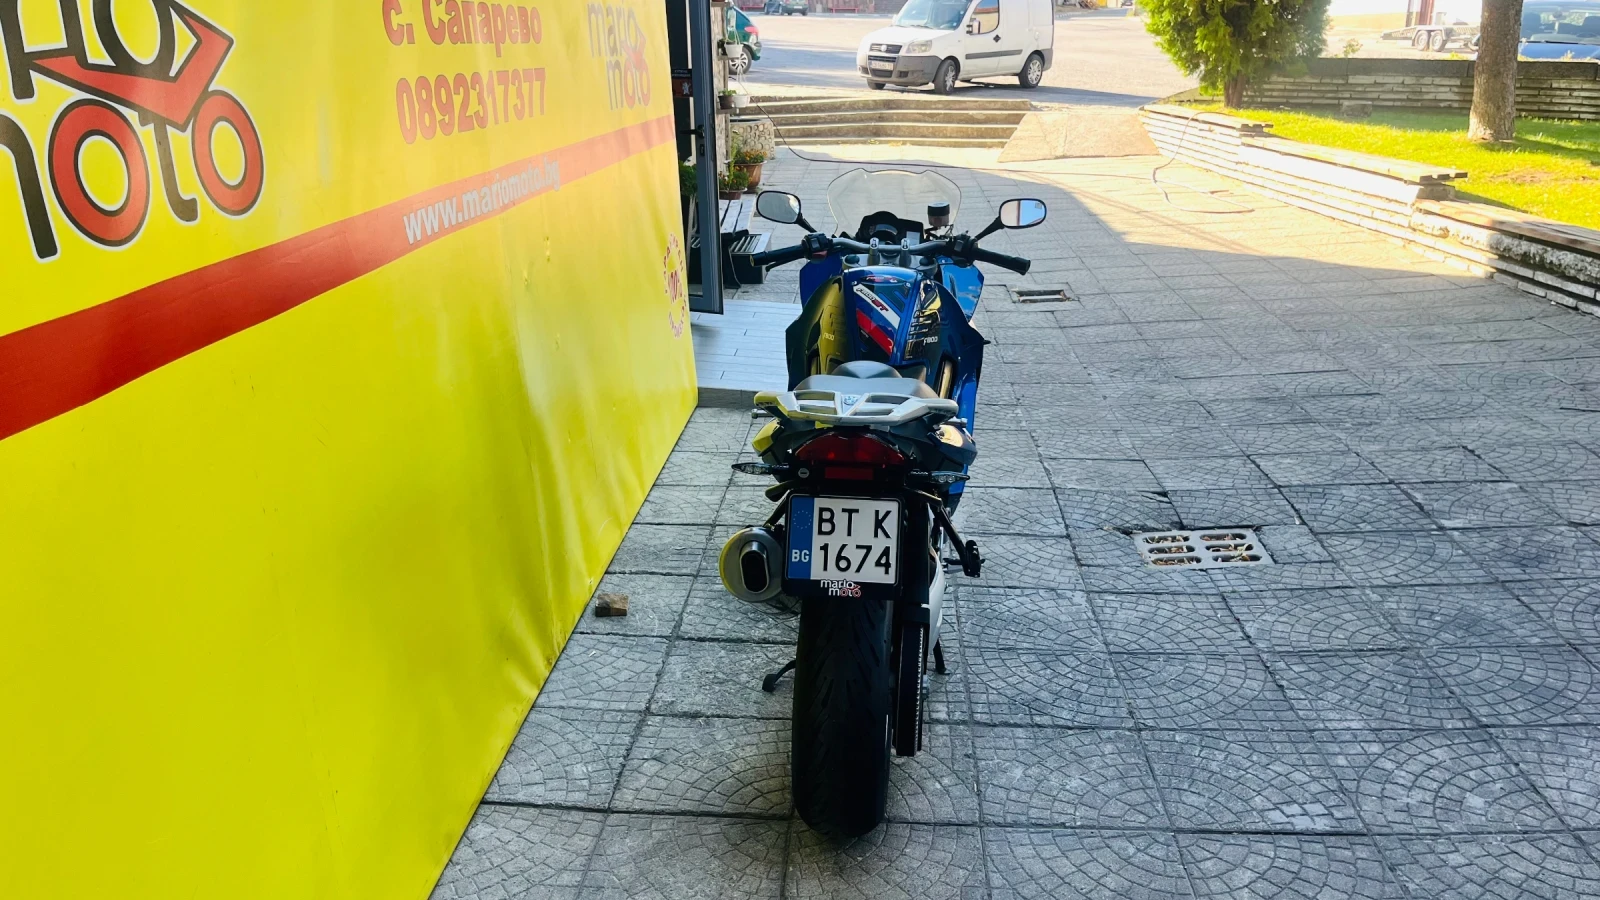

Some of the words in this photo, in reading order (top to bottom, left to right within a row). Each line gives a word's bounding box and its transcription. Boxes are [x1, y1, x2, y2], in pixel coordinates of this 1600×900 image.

[587, 0, 640, 58] mario
[396, 67, 546, 144] 0892317377
[606, 59, 651, 111] moto
[403, 155, 561, 245] www.mariomoto.bg
[791, 549, 810, 563] BG
[819, 542, 892, 575] 1674
[820, 578, 854, 589] mario
[828, 587, 862, 598] moto
